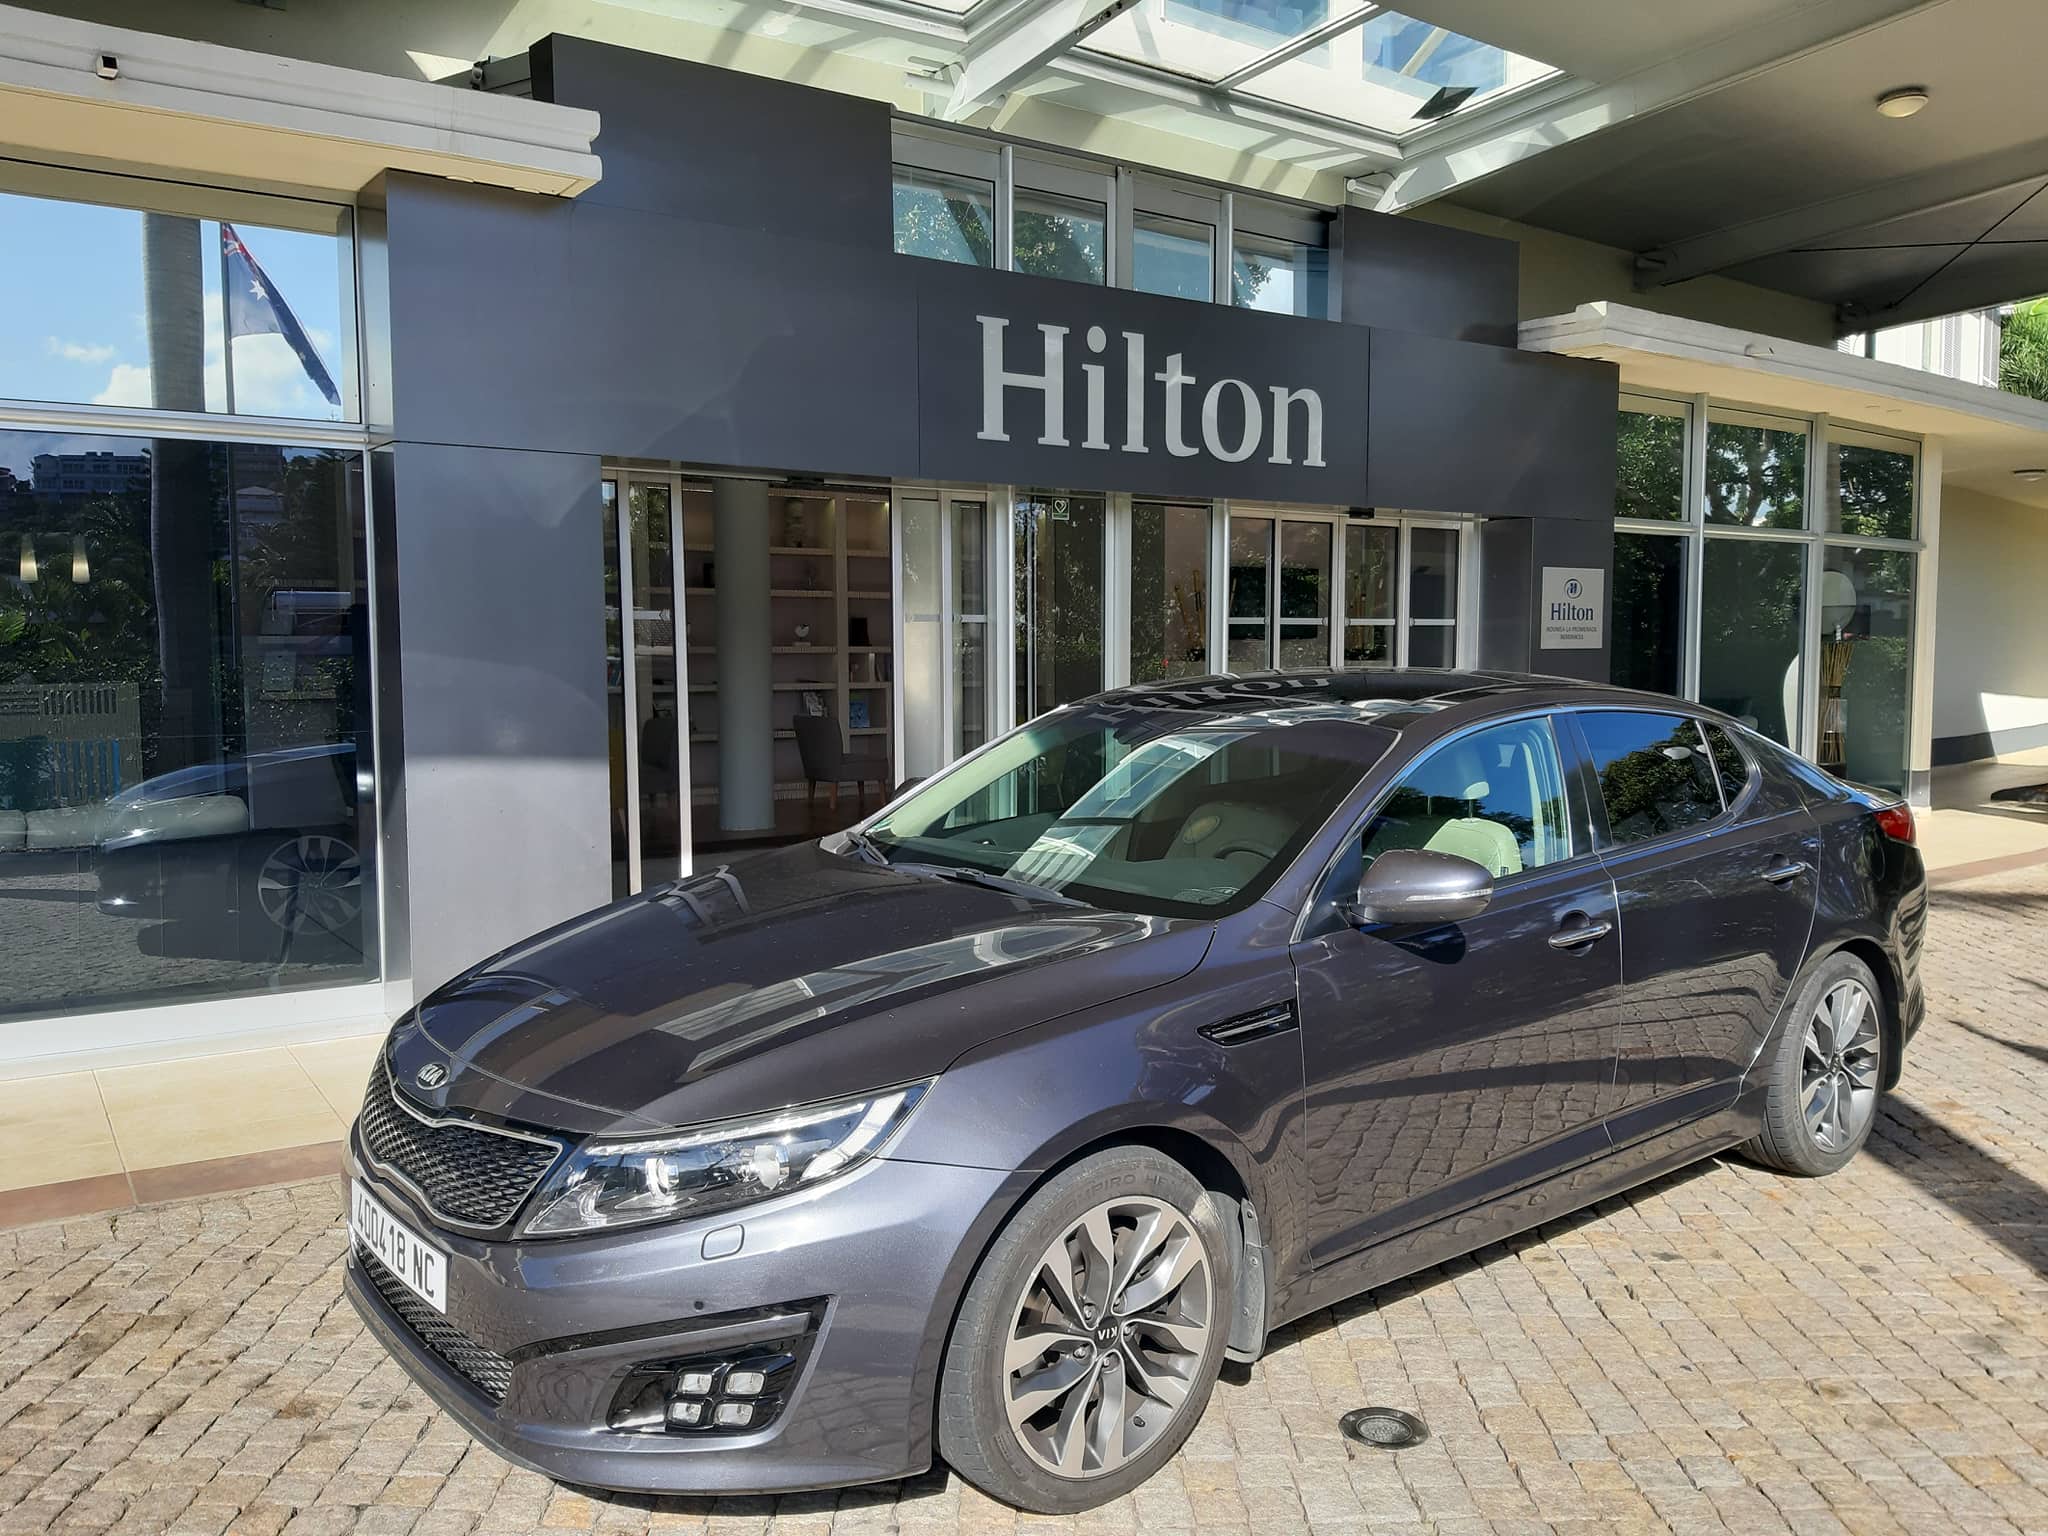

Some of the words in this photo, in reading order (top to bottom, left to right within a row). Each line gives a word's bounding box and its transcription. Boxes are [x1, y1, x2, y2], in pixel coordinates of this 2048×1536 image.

[976, 315, 1327, 468] Hilton
[1551, 602, 1594, 621] Hilton
[418, 1064, 444, 1086] KIA
[358, 1193, 406, 1275] 400418
[413, 1243, 435, 1299] NC
[1097, 1326, 1118, 1341] KIA
